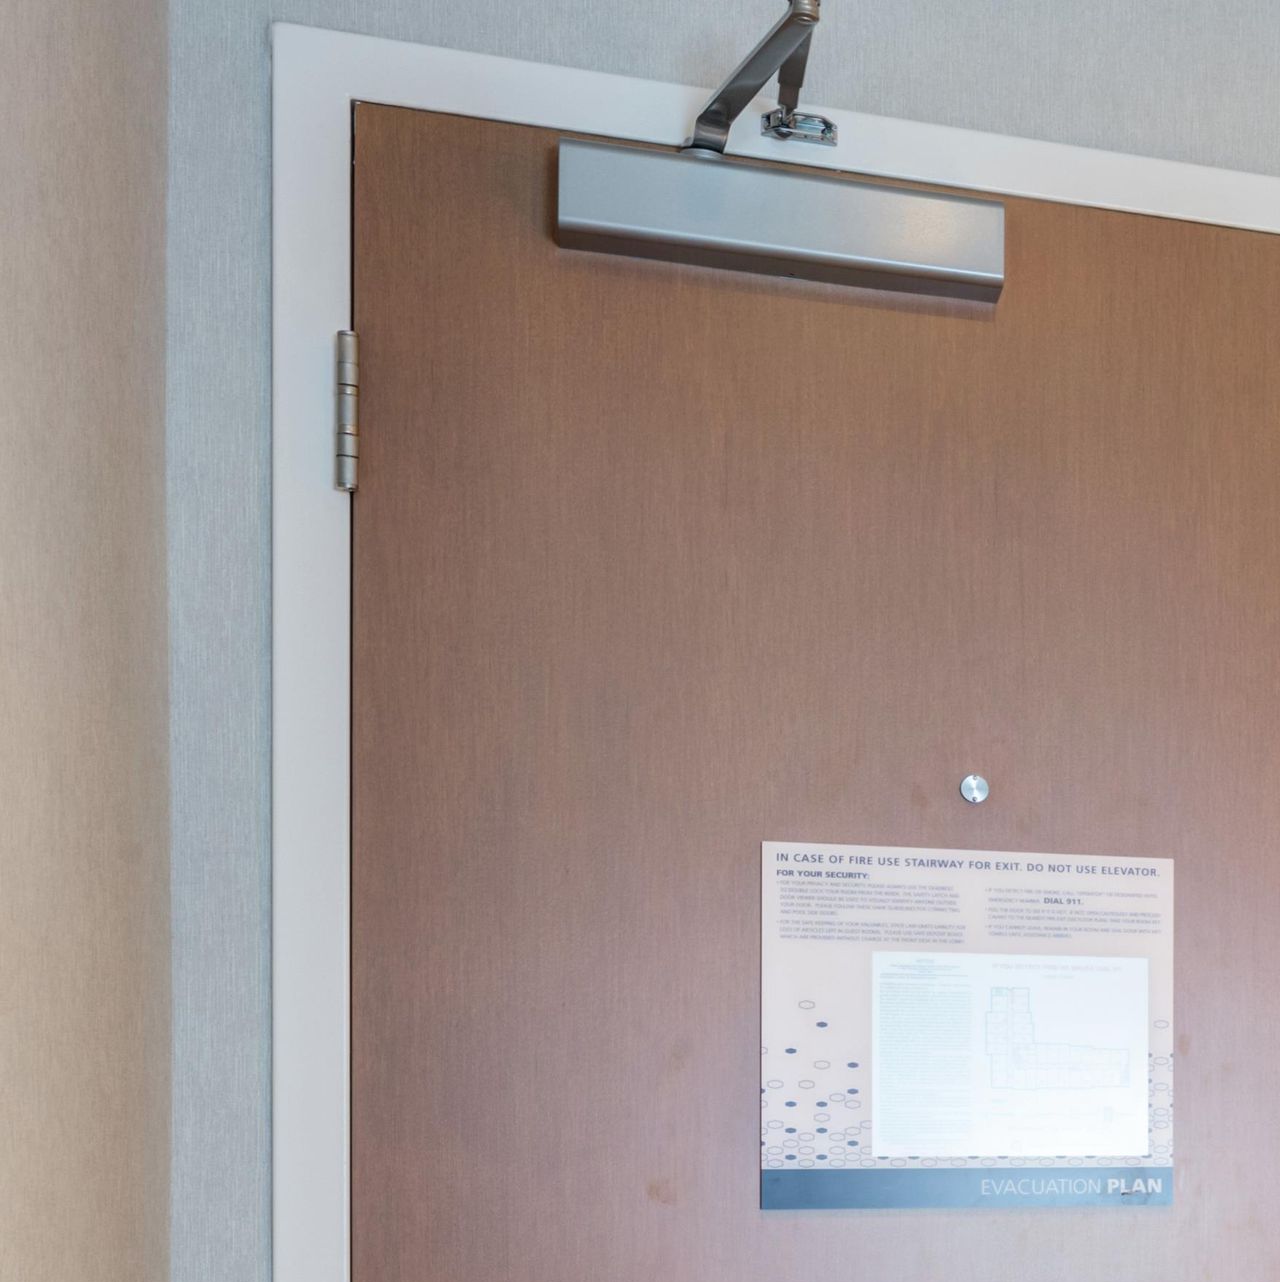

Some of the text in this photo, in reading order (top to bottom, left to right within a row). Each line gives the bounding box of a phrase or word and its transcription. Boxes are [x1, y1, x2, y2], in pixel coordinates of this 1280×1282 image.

[776, 853, 1160, 877] IN CASE OF FIRE USE STAIRWAY FOR EXIT. DO NOT USE ELEVATOR.
[776, 869, 869, 879] FOR YOUR SECURITY:
[1044, 897, 1063, 905] DIAL
[981, 1178, 1162, 1195] EVACUATION PLAN
